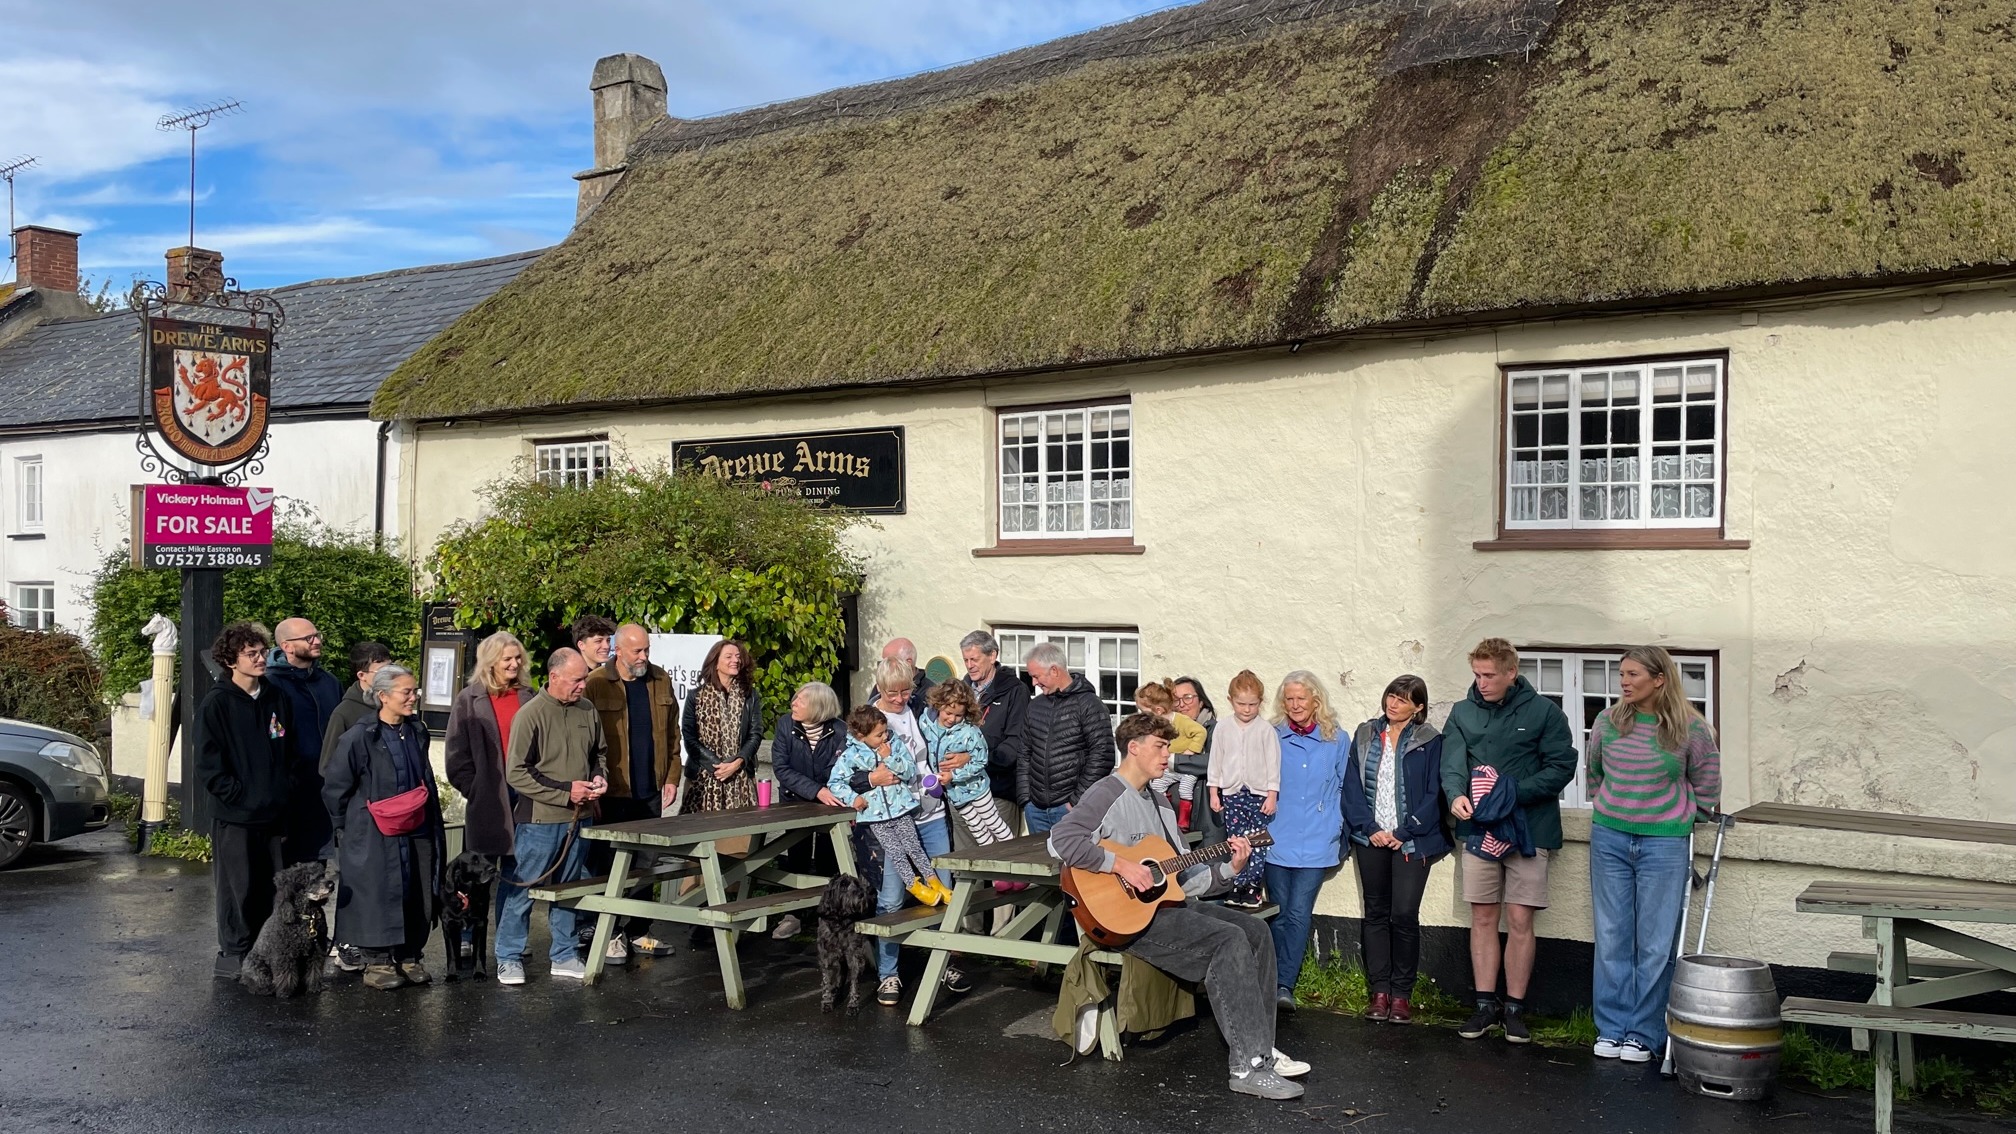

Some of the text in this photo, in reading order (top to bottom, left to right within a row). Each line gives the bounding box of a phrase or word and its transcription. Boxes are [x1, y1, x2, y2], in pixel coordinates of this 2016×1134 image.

[198, 324, 224, 335] THE
[153, 329, 267, 354] DREWE ARMS
[792, 441, 871, 478] Arms
[805, 486, 841, 496] DINING
[156, 493, 243, 507] Vickery Holman
[156, 515, 253, 535] FOR SALE
[155, 545, 187, 553] Contact:
[188, 545, 206, 553] Mike
[155, 553, 262, 566] 07527 388045
